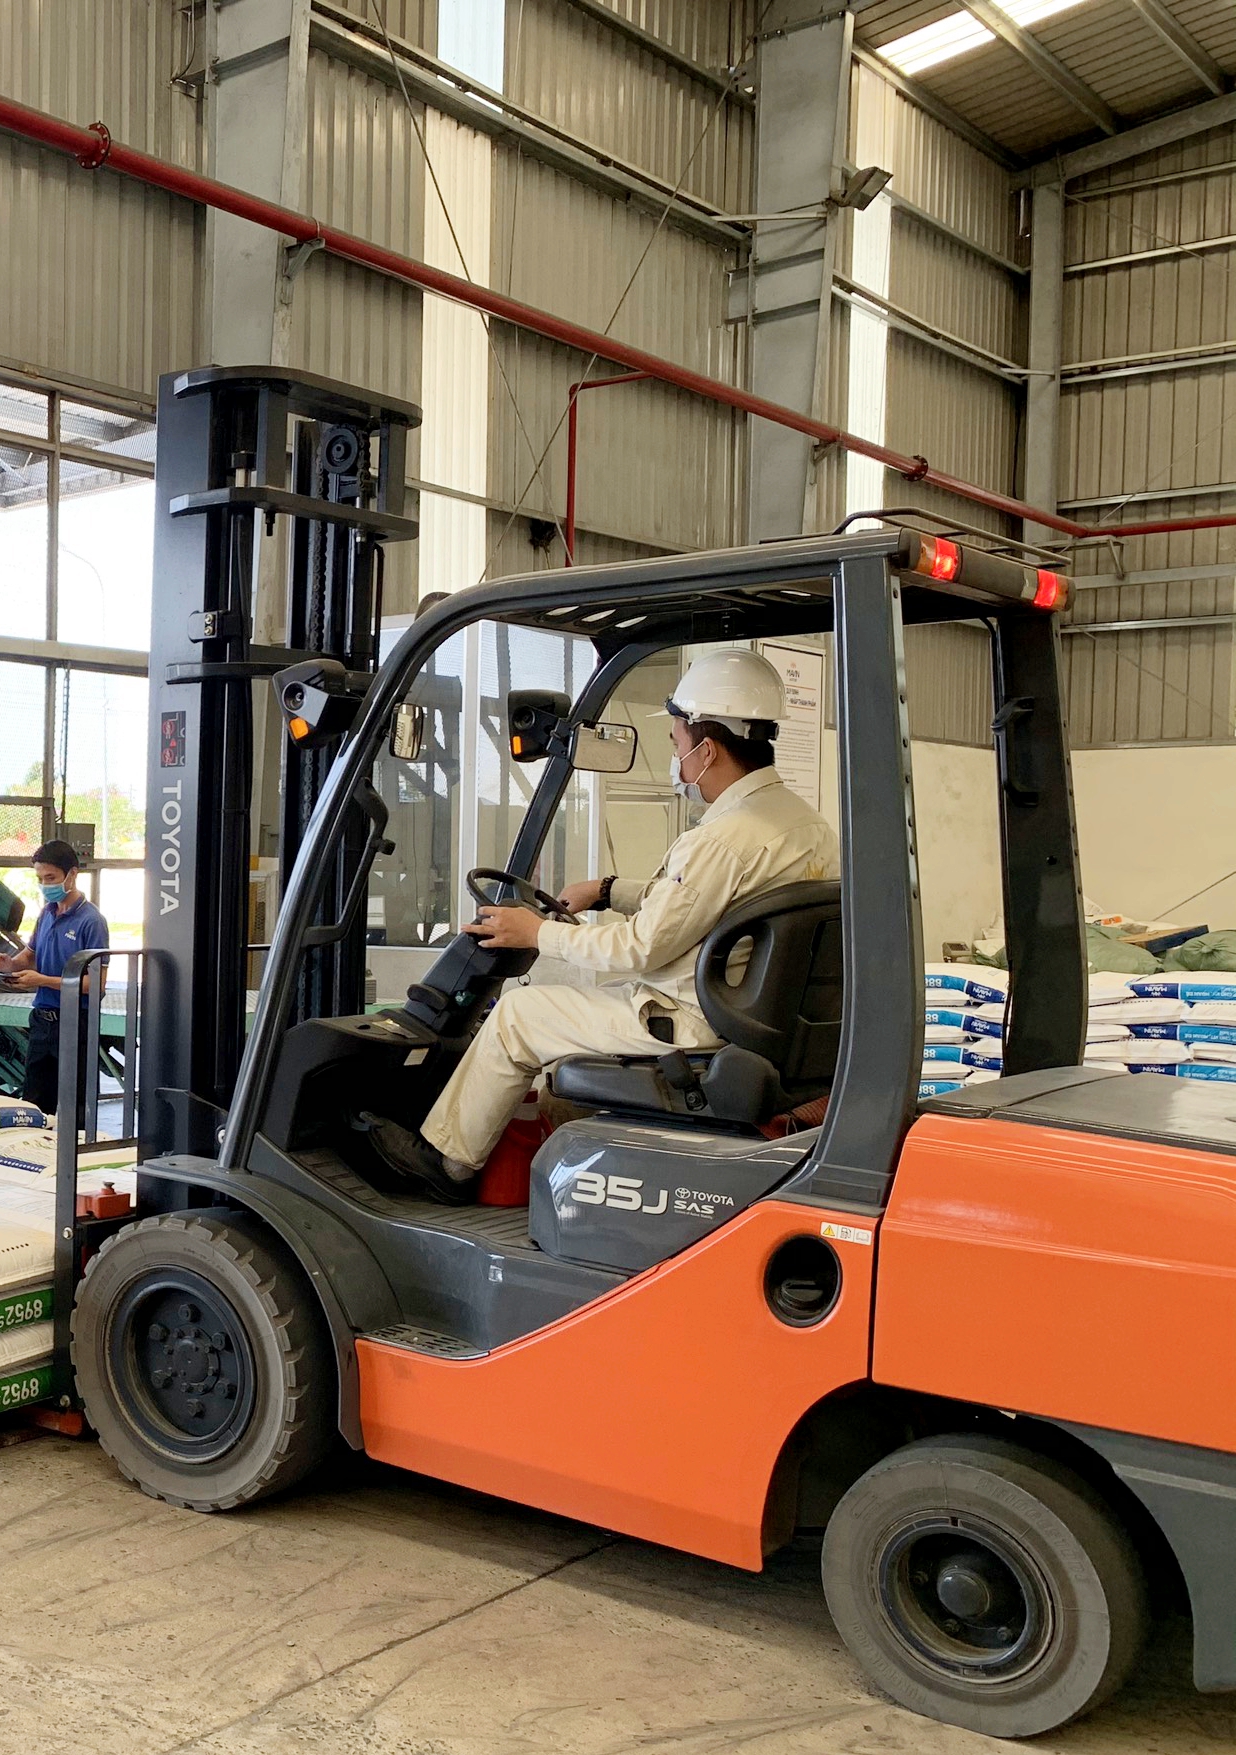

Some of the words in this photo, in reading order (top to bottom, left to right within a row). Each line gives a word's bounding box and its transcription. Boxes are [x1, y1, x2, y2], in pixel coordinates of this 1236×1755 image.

[159, 780, 182, 916] TOYOTA
[925, 1013, 939, 1022] 88
[924, 1048, 936, 1058] 88
[12, 1115, 34, 1124] MAVIN
[570, 1170, 669, 1215] 35J
[692, 1191, 735, 1207] TOYOTA
[673, 1200, 715, 1214] SAS
